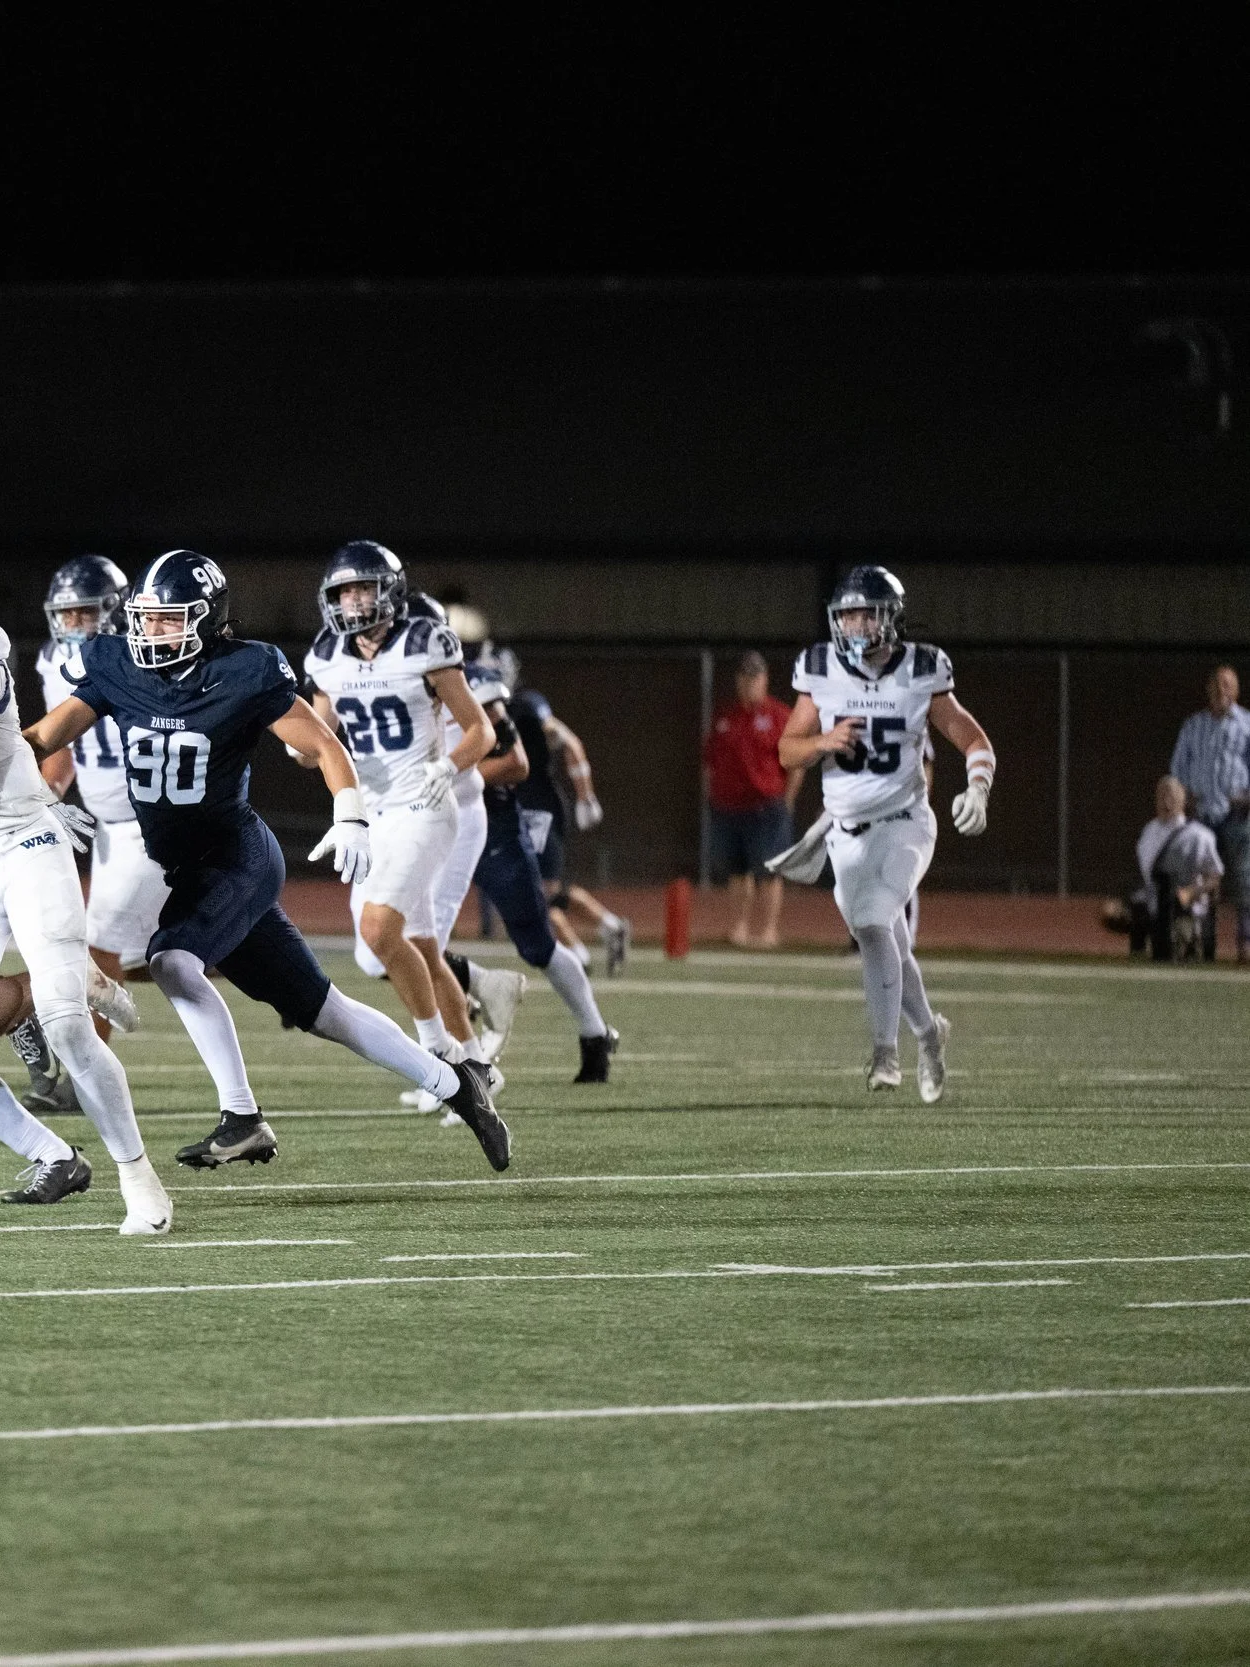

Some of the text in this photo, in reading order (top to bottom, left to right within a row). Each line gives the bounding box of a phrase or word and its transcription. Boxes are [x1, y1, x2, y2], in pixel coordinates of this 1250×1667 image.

[192, 563, 223, 597] 90
[340, 681, 389, 692] CHAMPION
[846, 699, 896, 710] CHAMPION
[151, 716, 186, 730] RANGERS
[335, 694, 415, 754] 20
[127, 726, 211, 805] 90
